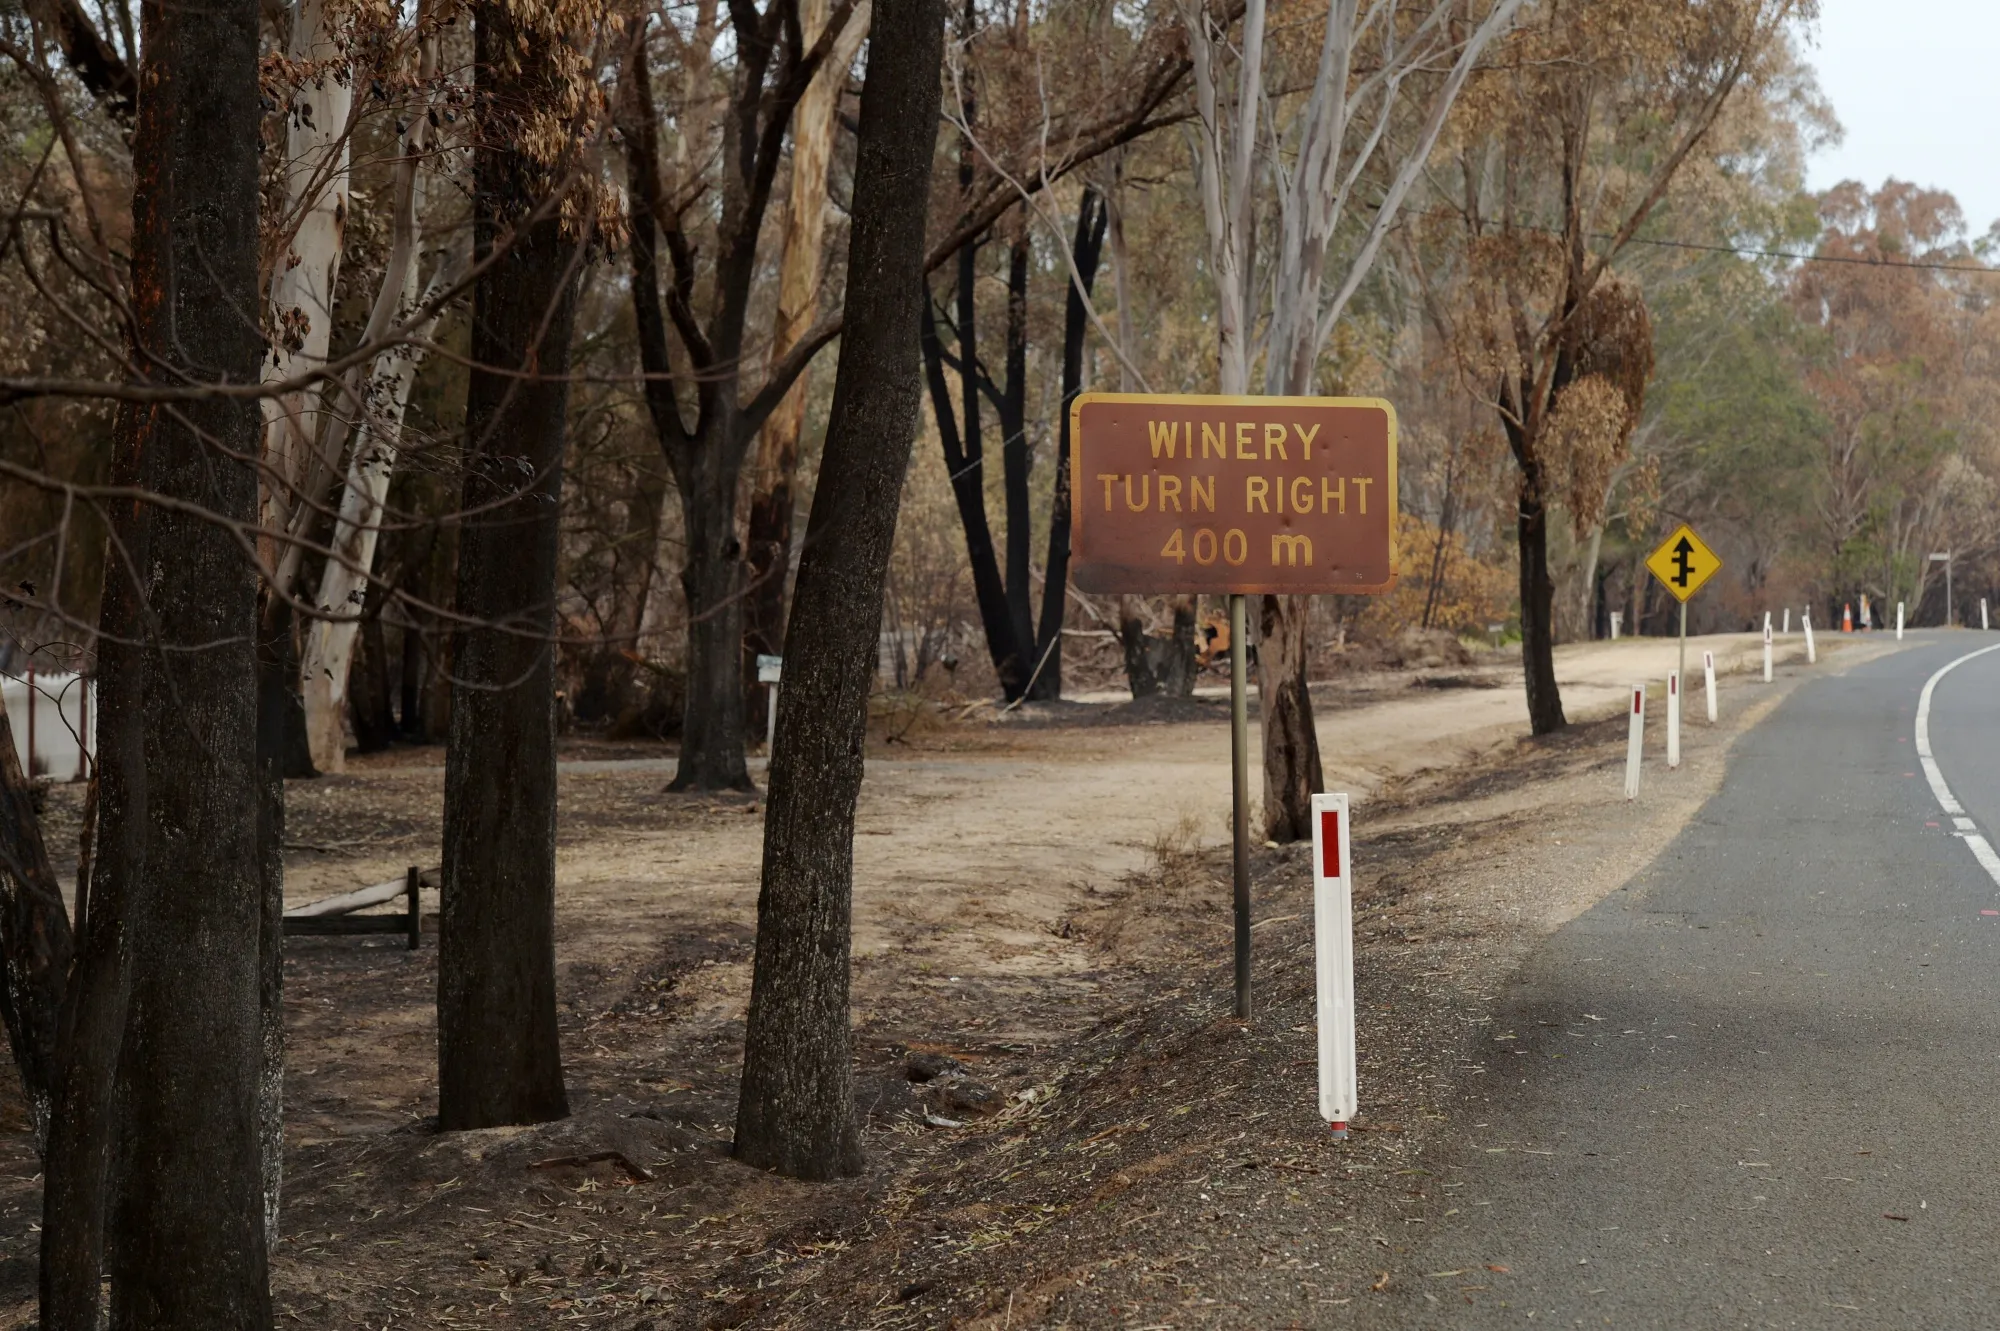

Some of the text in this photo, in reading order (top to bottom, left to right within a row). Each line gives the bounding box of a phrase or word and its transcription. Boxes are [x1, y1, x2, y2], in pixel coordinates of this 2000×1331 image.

[1148, 420, 1321, 460] WINERY
[1097, 474, 1373, 514] TURN RIGHT
[1160, 528, 1313, 567] 400 m
